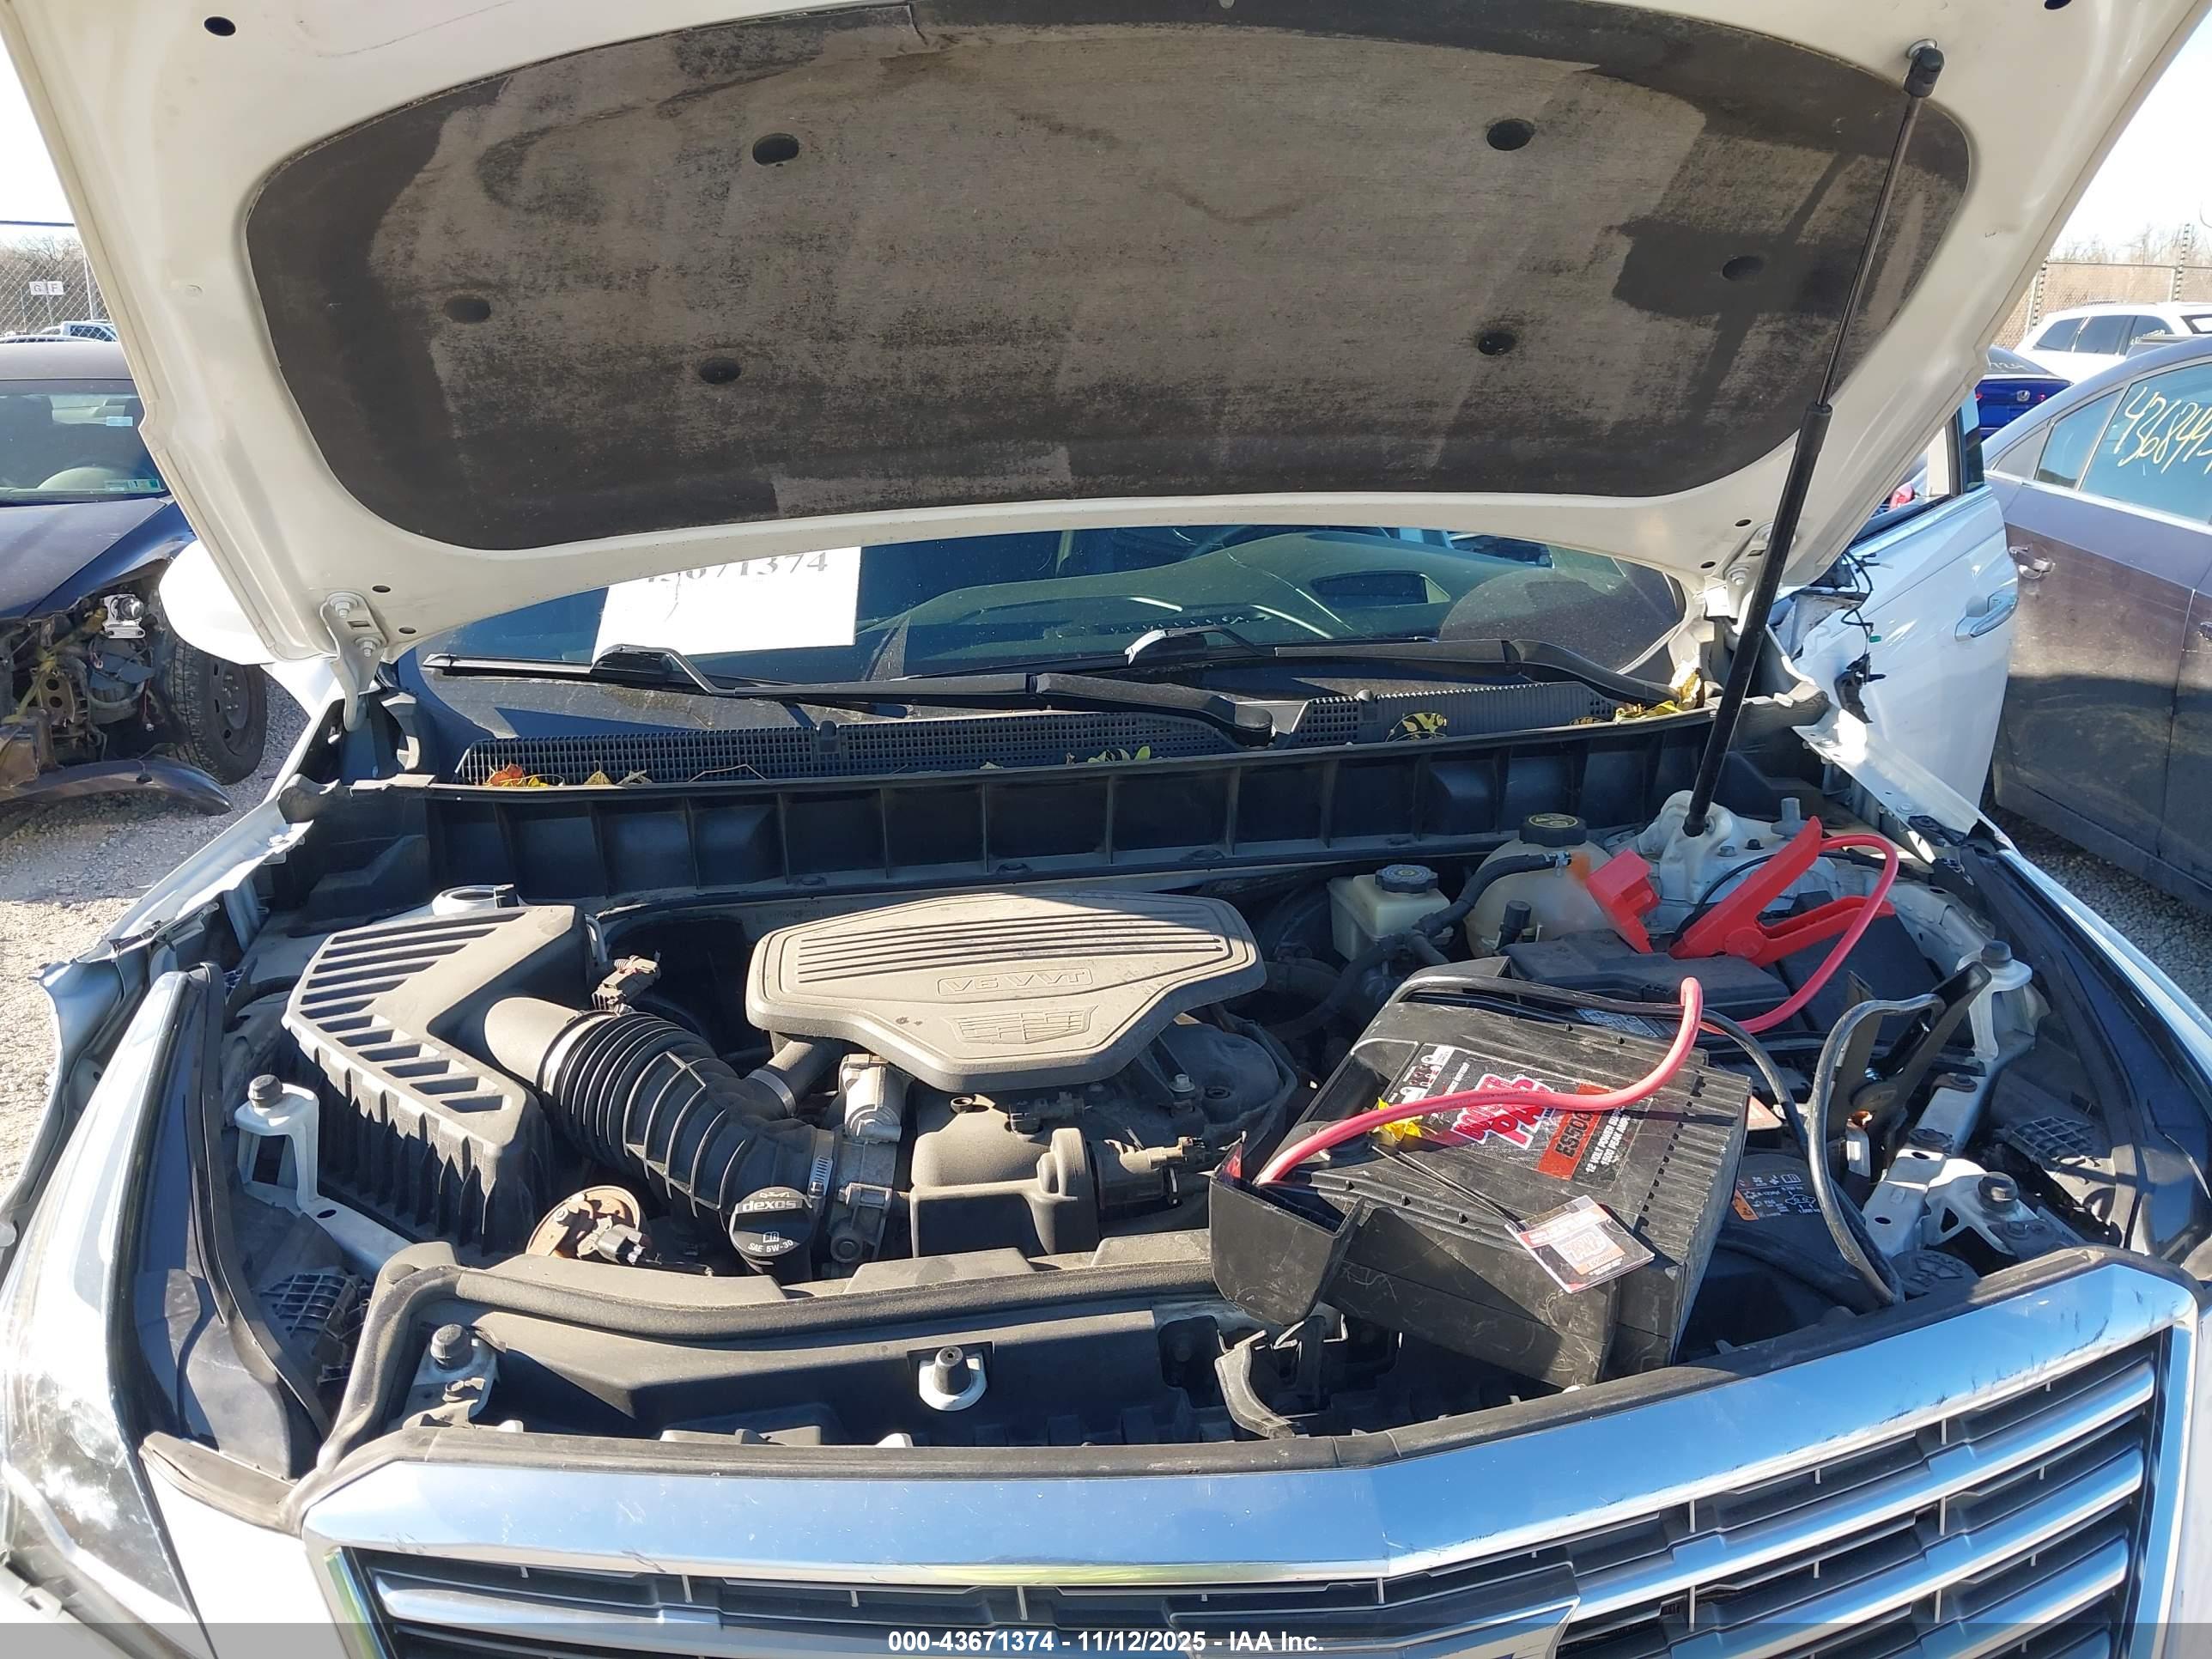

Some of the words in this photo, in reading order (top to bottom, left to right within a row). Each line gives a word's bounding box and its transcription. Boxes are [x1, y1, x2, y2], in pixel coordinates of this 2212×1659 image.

[52, 283, 58, 293] F
[942, 977, 999, 992] V6
[1004, 971, 1086, 988] VVT
[1616, 1114, 1631, 1133] AMPS
[1597, 1124, 1615, 1148] POWER
[1607, 1131, 1623, 1150] PEAK
[1589, 1146, 1604, 1164] VOLT
[1600, 1148, 1615, 1165] 1500
[1585, 1163, 1597, 1173] 12
[742, 1200, 797, 1212] dexos
[747, 1243, 764, 1253] SAE
[766, 1239, 793, 1253] 5W-30
